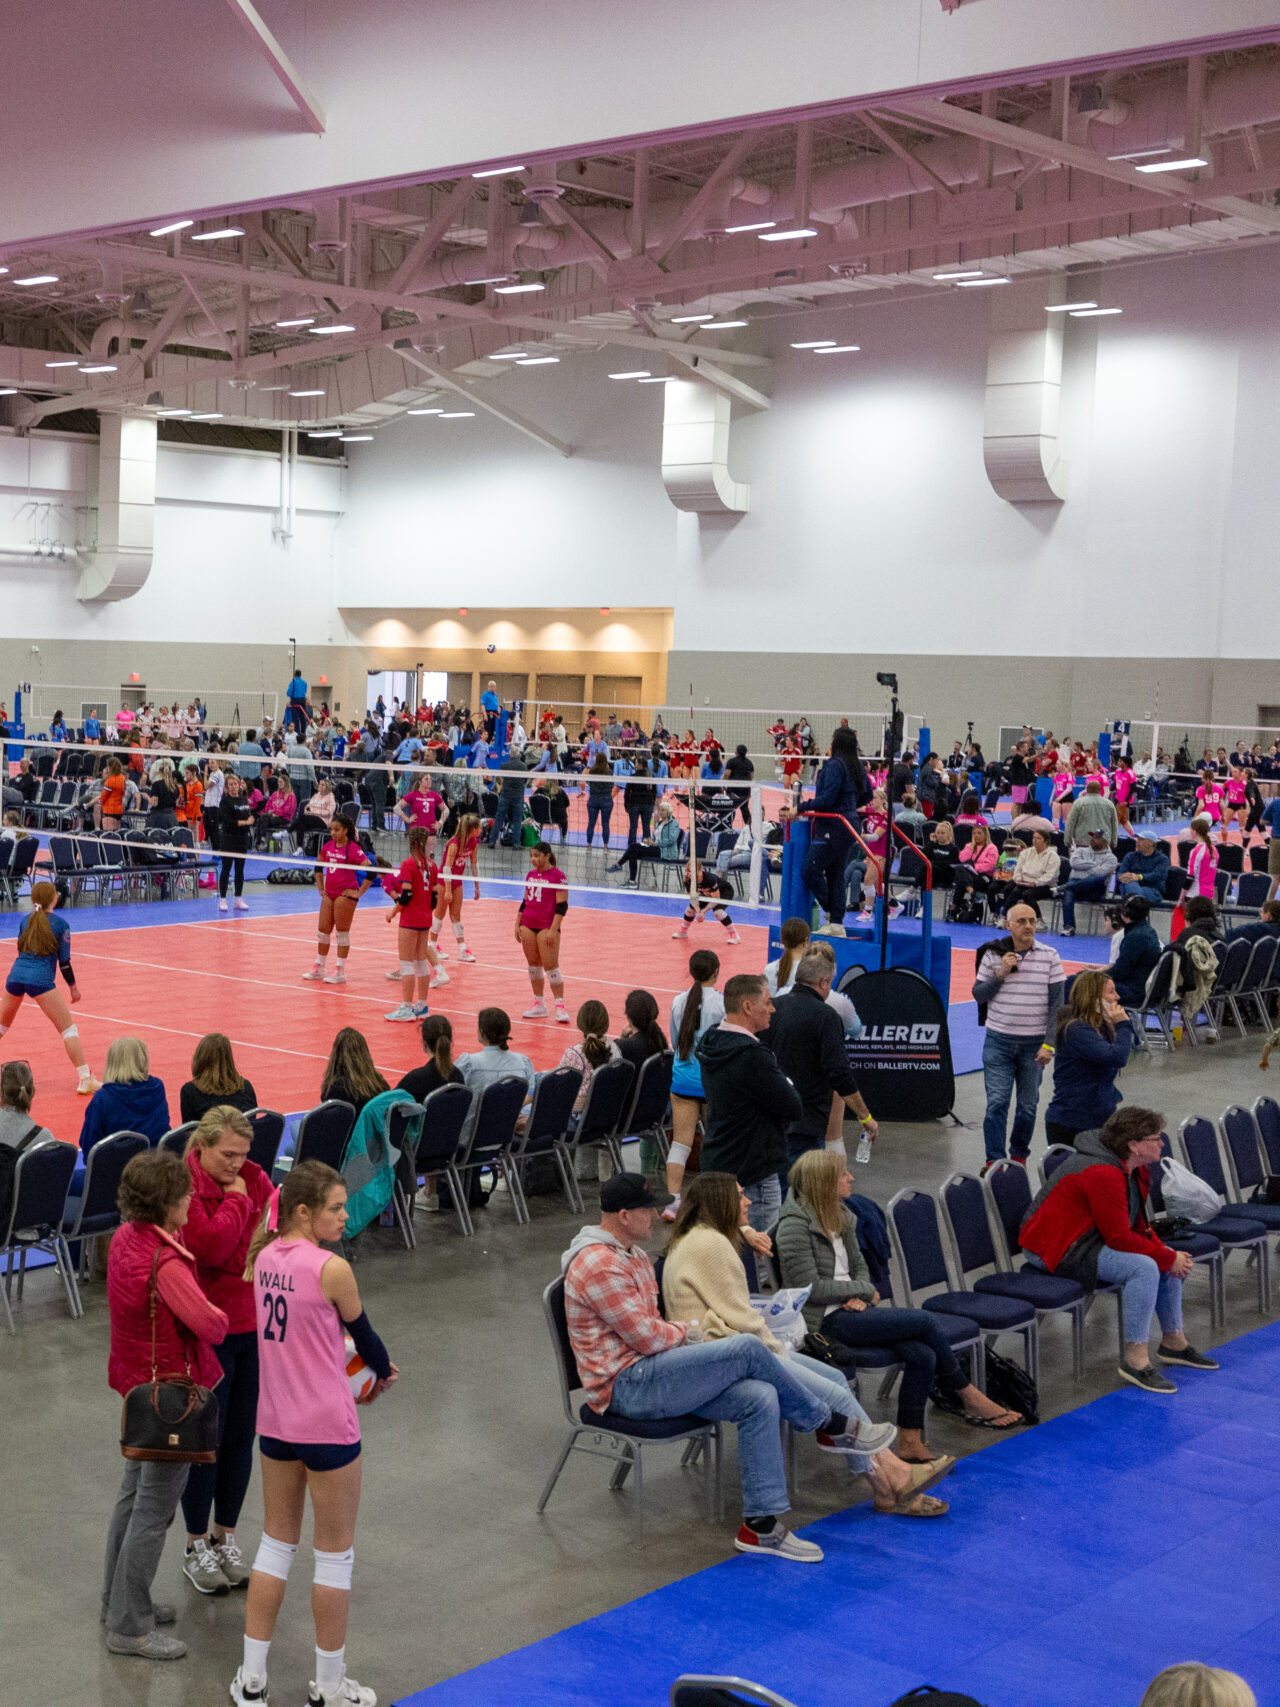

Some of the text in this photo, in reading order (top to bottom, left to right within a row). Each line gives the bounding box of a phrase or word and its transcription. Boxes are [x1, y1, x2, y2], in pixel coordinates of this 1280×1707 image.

[1118, 722, 1126, 734] 4
[422, 801, 430, 814] 3
[527, 886, 543, 902] 34
[878, 1062, 940, 1070] BALLERTV.COM
[259, 1270, 295, 1293] WALL
[263, 1292, 288, 1343] 29
